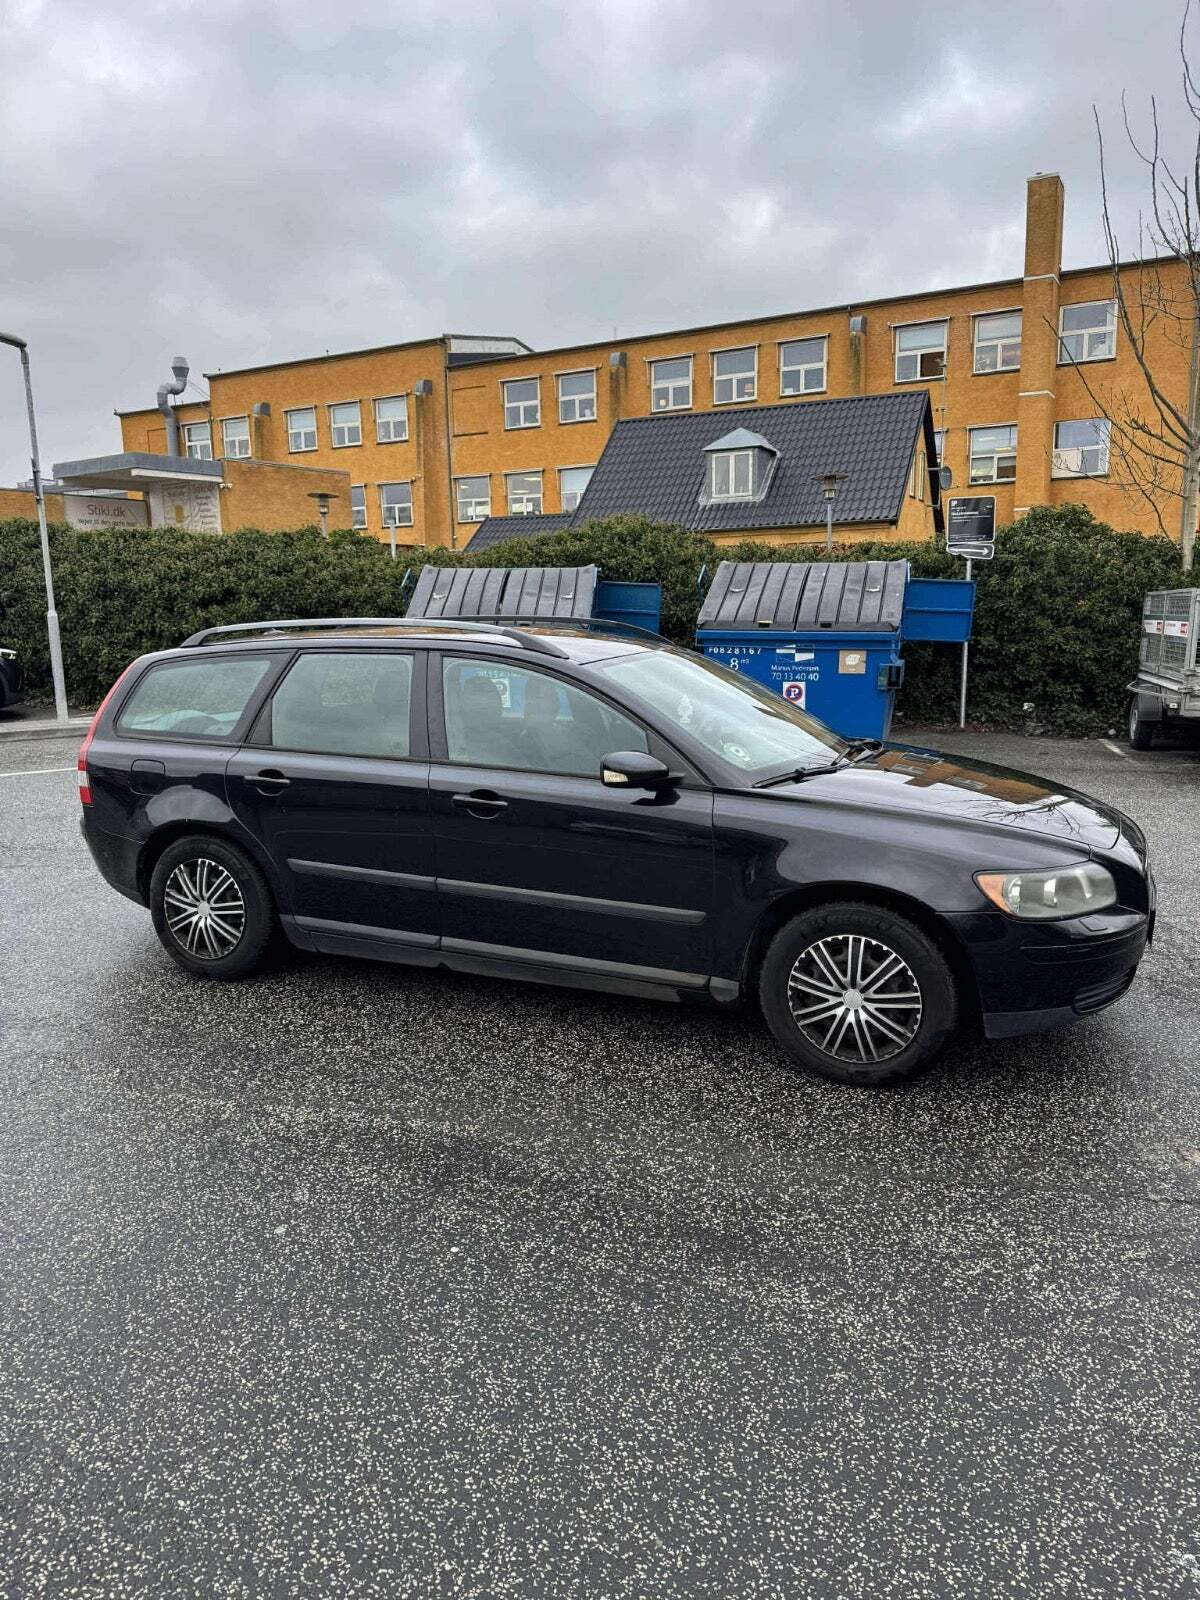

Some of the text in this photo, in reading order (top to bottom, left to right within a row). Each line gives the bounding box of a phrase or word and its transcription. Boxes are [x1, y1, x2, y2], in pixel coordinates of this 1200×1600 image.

[730, 658, 739, 670] 8
[771, 672, 819, 681] 70 13 40 40
[790, 688, 799, 698] P
